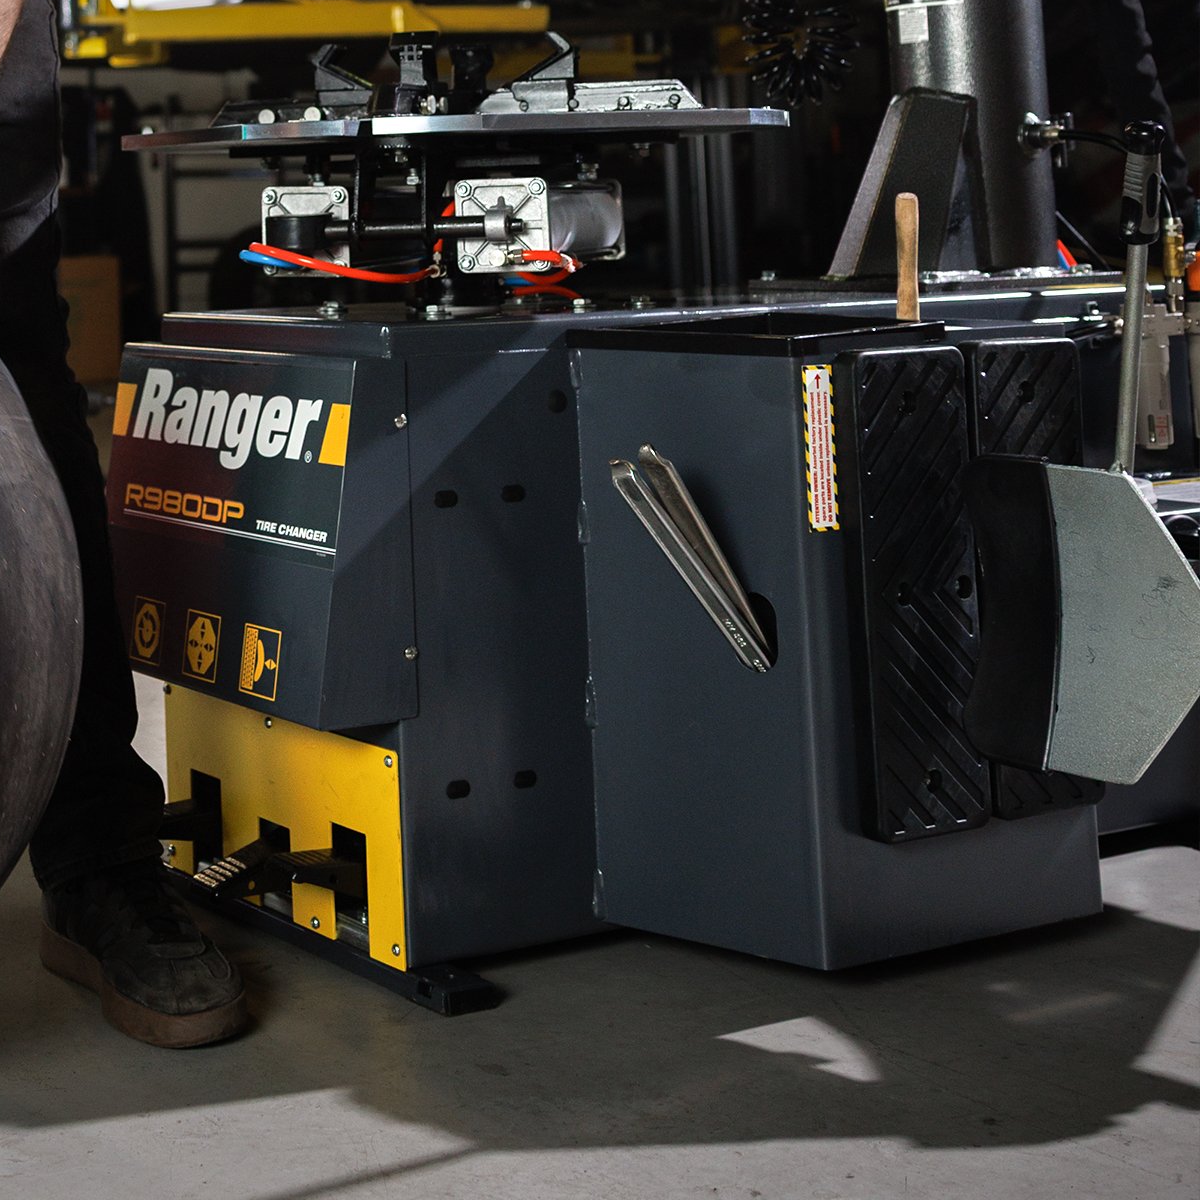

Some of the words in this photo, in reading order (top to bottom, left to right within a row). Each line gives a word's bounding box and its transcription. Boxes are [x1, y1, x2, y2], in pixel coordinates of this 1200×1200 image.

[124, 483, 245, 523] R980DP
[255, 519, 277, 534] TIRE
[278, 523, 328, 543] CHANGER
